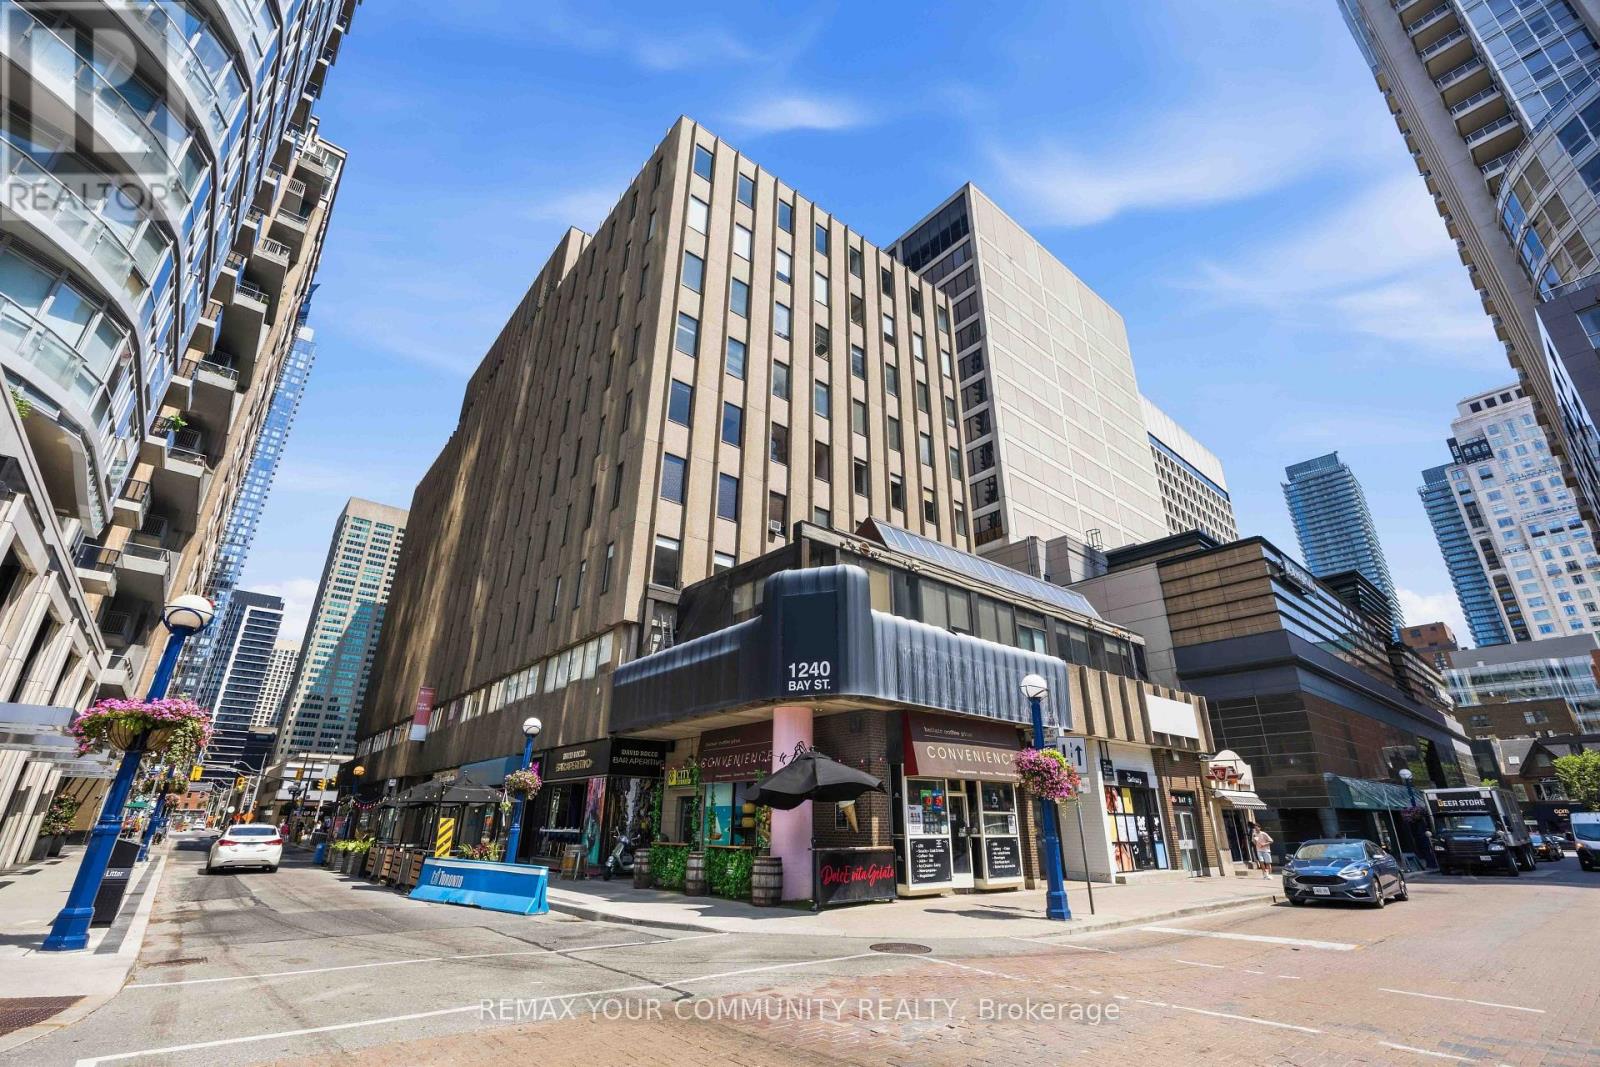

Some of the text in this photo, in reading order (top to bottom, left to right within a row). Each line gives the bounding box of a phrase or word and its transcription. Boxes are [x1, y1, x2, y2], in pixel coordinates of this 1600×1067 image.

[788, 660, 831, 678] 1240
[788, 678, 831, 691] BAY ST.
[612, 756, 628, 764] BAR
[640, 750, 659, 758] ROCCO
[700, 750, 773, 769] CONVENIENCE
